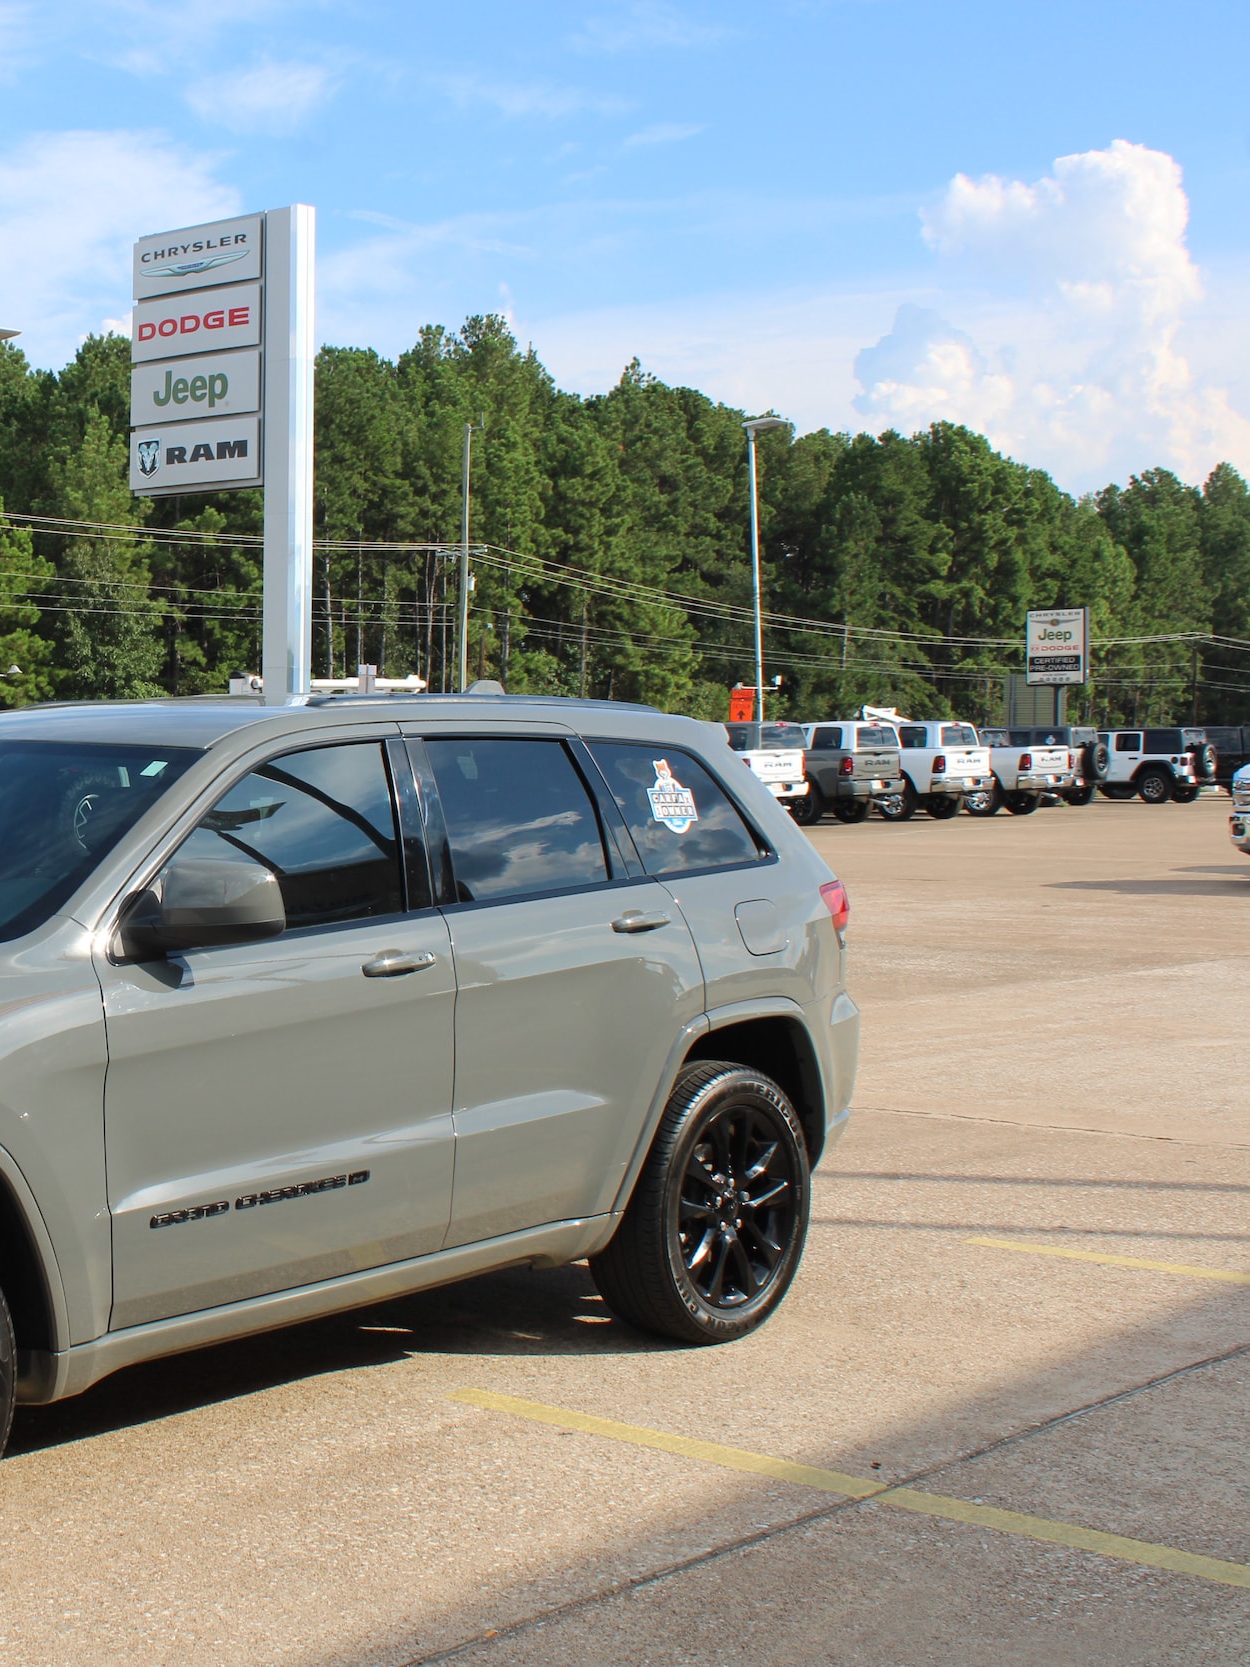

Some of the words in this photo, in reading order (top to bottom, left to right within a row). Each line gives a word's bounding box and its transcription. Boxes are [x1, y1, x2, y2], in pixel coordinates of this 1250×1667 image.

[140, 233, 247, 264] CHRYSLER
[138, 306, 250, 342] DODGE
[152, 370, 229, 408] Jeep
[165, 439, 249, 466] RAM
[1038, 628, 1072, 642] Jeep
[1029, 663, 1080, 672] PRE-OWNED
[651, 792, 691, 804] CARFAX
[149, 1200, 230, 1229] GRAND
[234, 1174, 347, 1211] CHEROKEE
